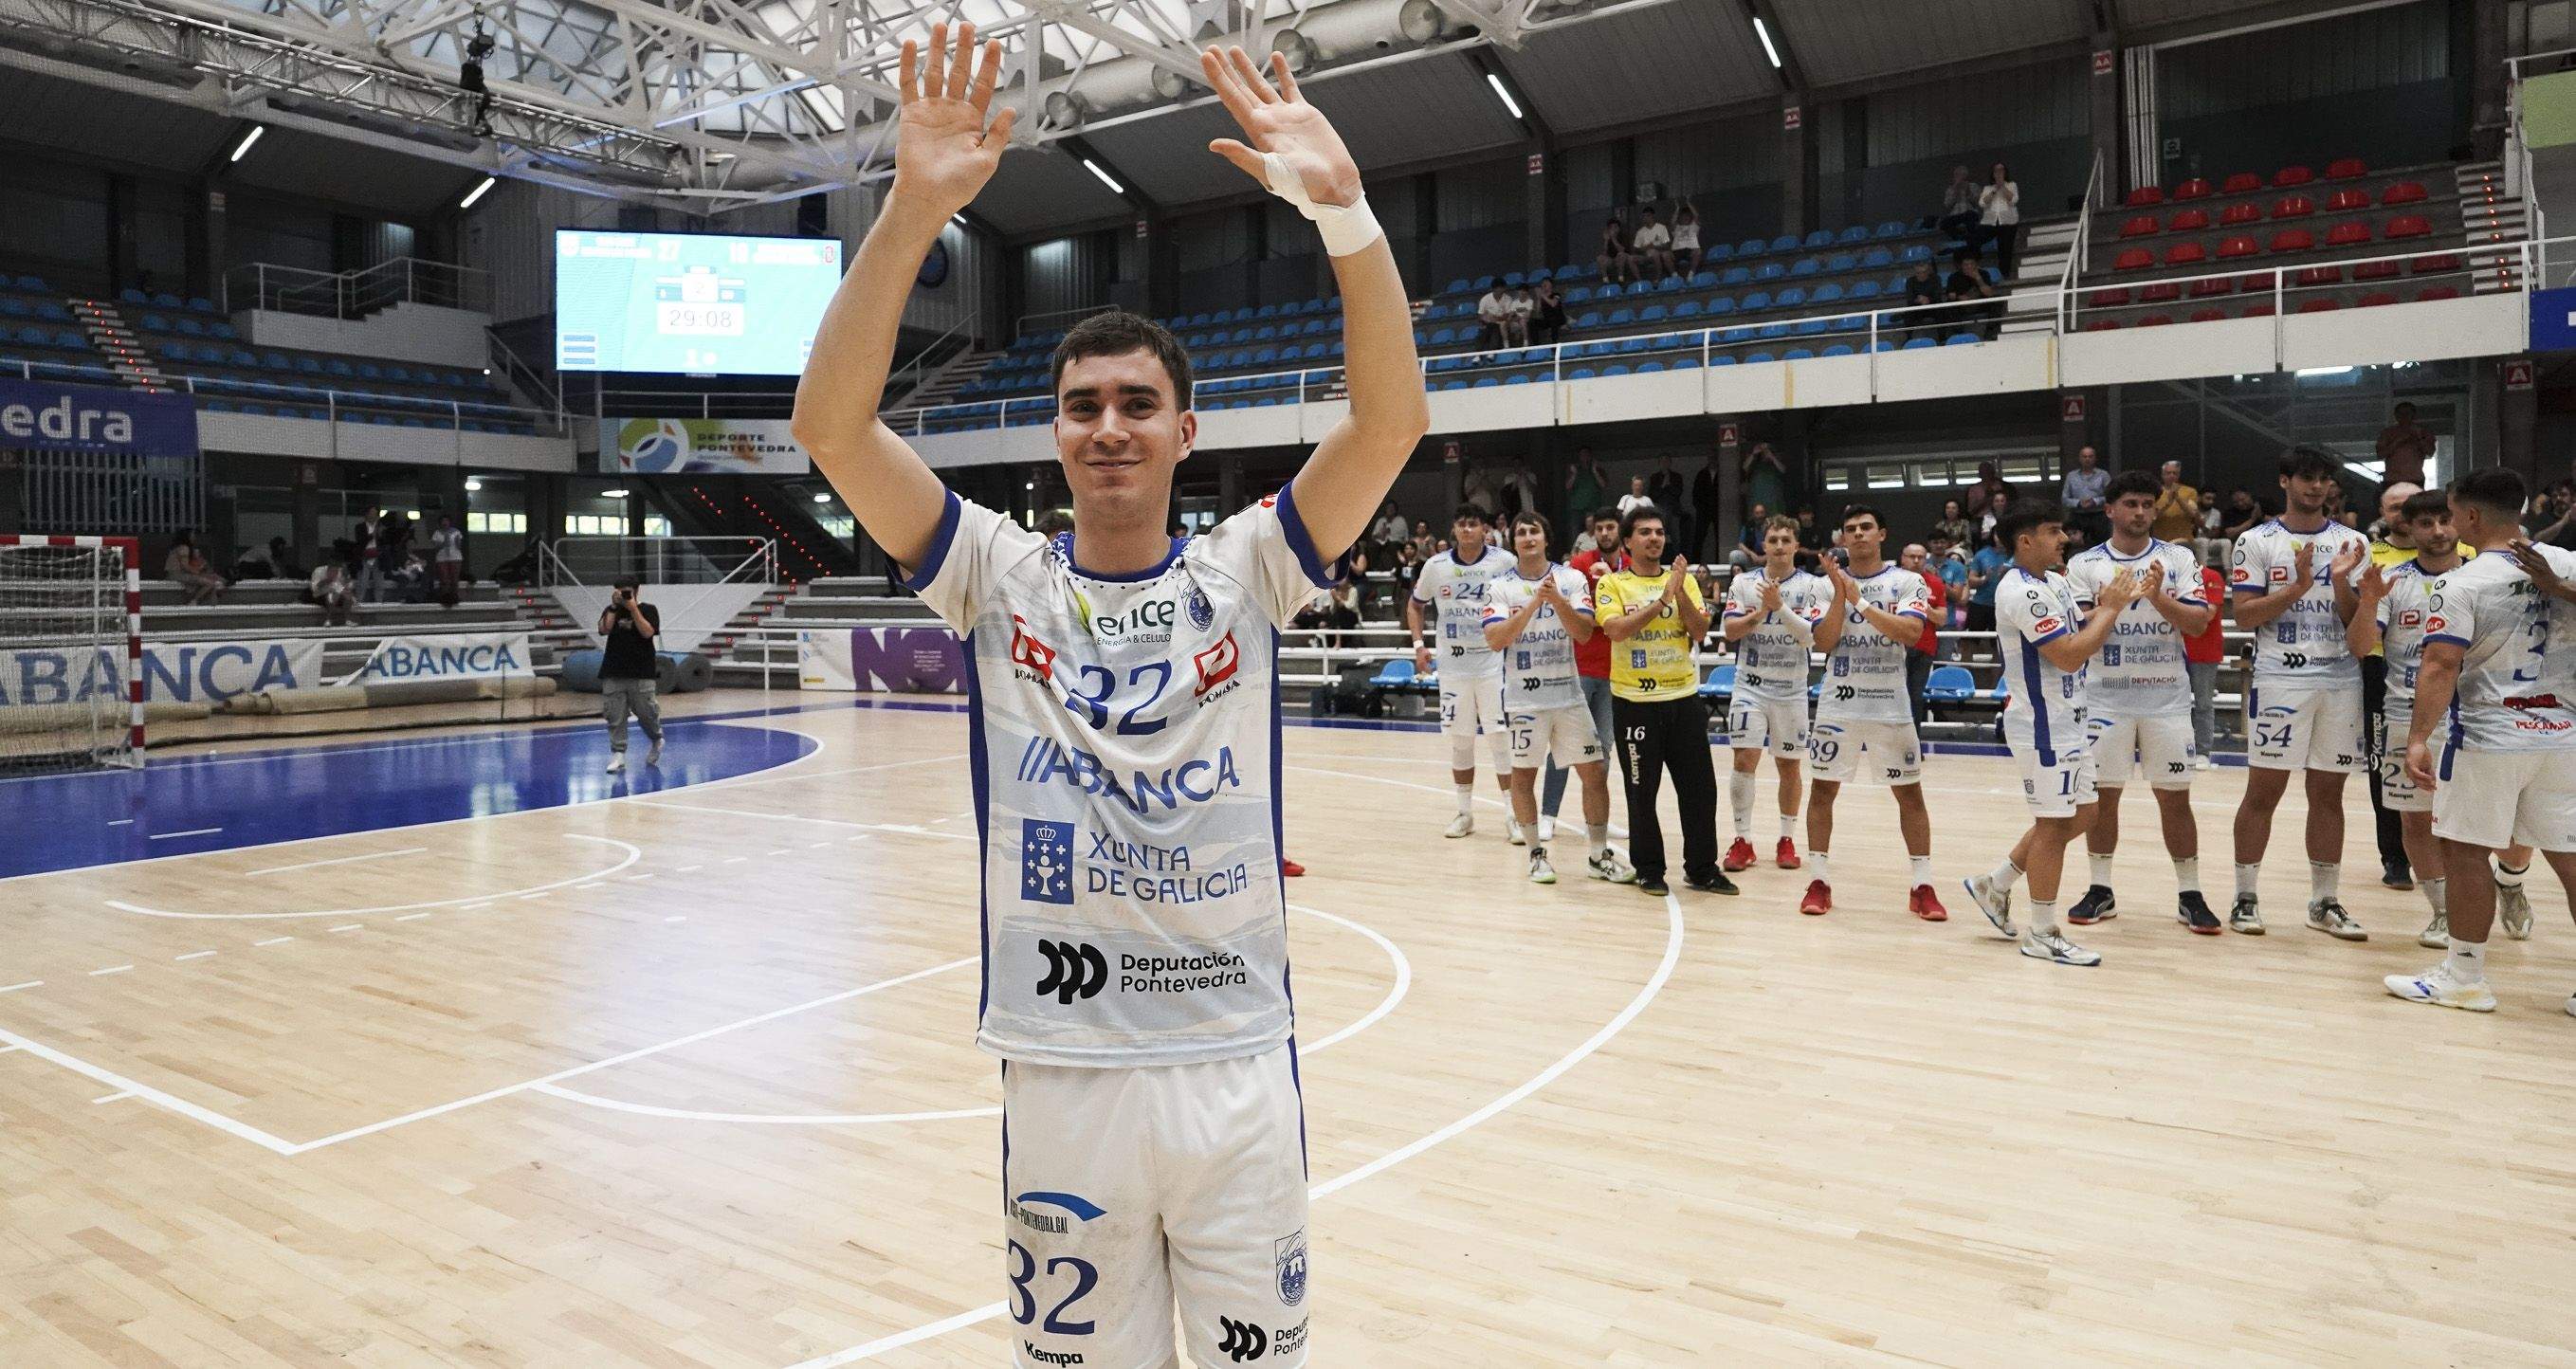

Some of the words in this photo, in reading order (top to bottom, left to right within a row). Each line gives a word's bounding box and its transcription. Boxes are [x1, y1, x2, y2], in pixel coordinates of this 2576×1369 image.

[669, 310, 733, 327] 29:08
[2512, 368, 2527, 381] A
[2067, 401, 2080, 414] A
[1, 395, 132, 443] edra
[697, 433, 765, 442] DEPORTE
[1724, 429, 1734, 440] A
[697, 445, 796, 453] PONTEVEDRA
[2313, 563, 2332, 586] 4
[1455, 582, 1485, 600] 24
[1449, 607, 1480, 617] ABAN
[1537, 602, 1555, 619] 15
[1133, 634, 1140, 643] &
[362, 643, 520, 678] ABANCA
[1065, 658, 1172, 735] 32
[1511, 729, 1533, 750] 15
[1624, 726, 1647, 741] 16
[2254, 723, 2292, 747] 54
[1810, 738, 1839, 763] 89
[1039, 741, 1240, 814] ABANCA
[1088, 831, 1191, 871] XUNTA
[1087, 867, 1126, 897] DE
[1133, 863, 1247, 904] GALICIA
[1121, 951, 1246, 977] Deputación
[1121, 971, 1247, 993] Pontevedra
[1008, 1237, 1099, 1336] 32
[1024, 1339, 1085, 1369] Kempa
